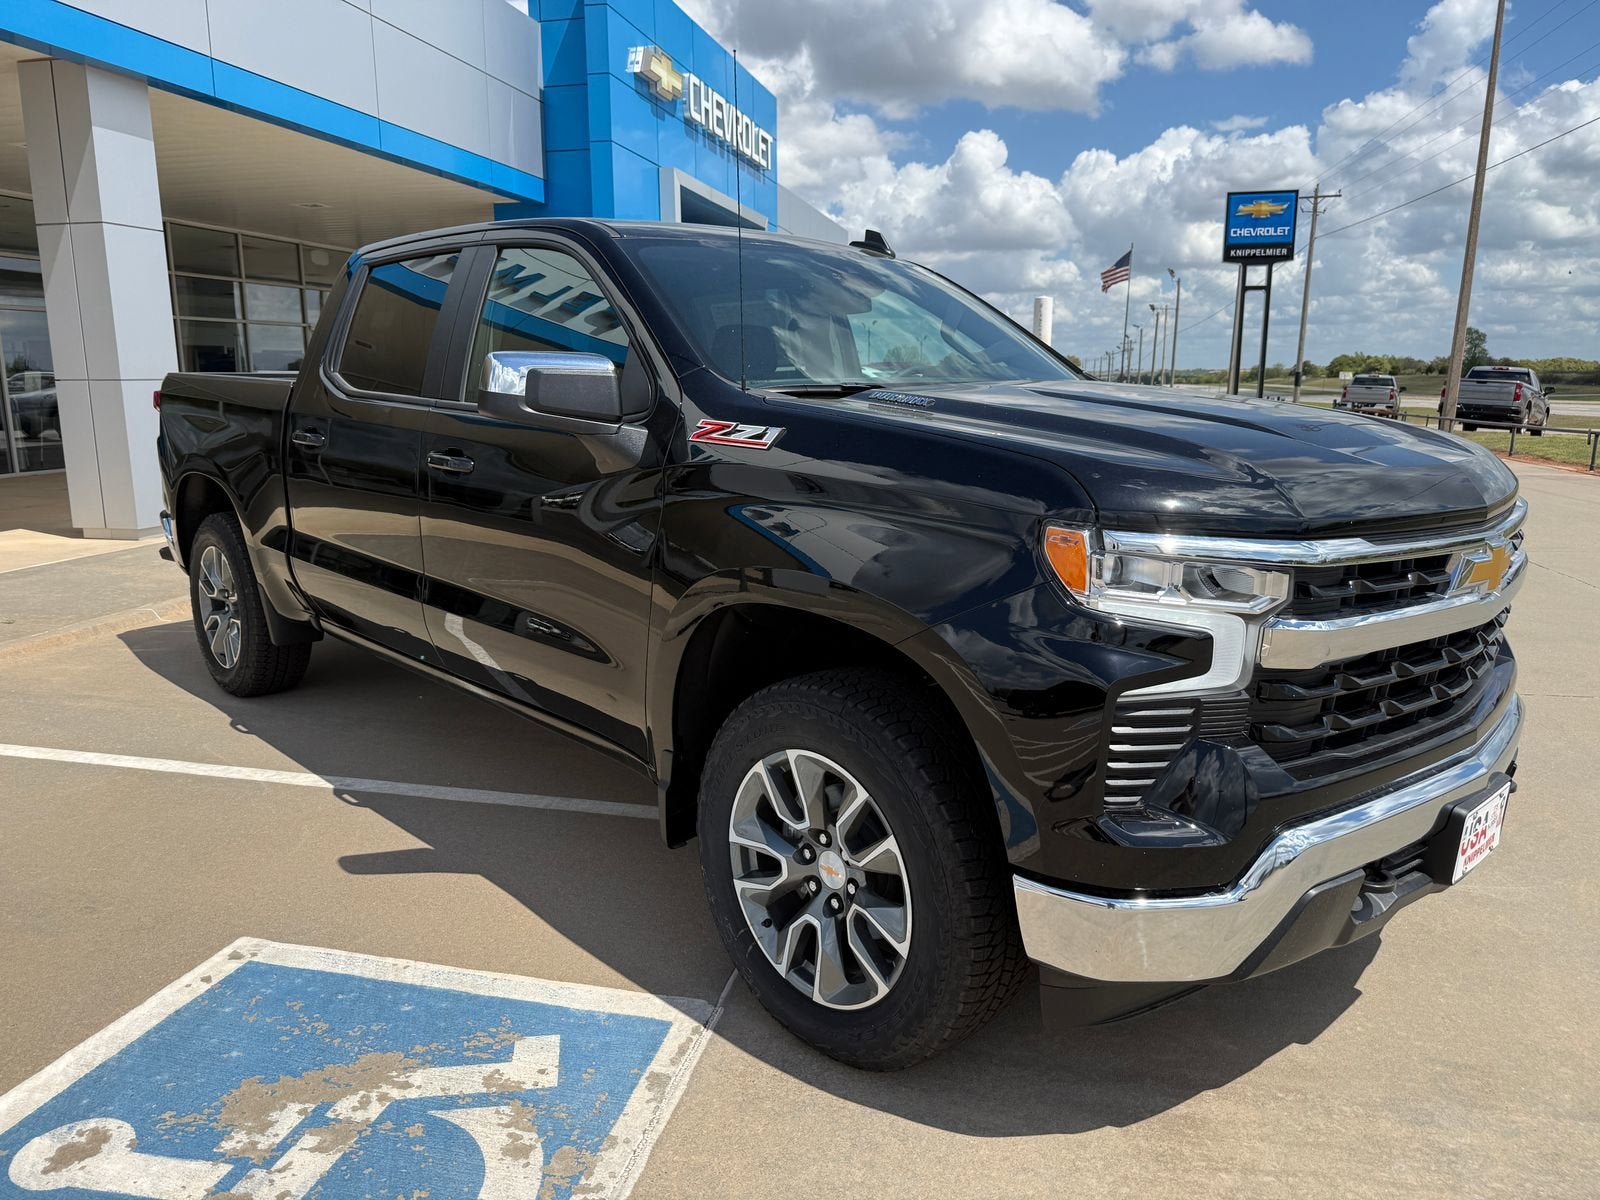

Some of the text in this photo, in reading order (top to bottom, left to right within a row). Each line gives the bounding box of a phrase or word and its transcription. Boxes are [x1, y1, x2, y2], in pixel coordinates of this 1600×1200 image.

[686, 73, 773, 170] CHEVROLET
[1230, 226, 1291, 237] CHEVROLET
[1230, 248, 1288, 257] KNIPPELMIER
[689, 419, 786, 450] Z71
